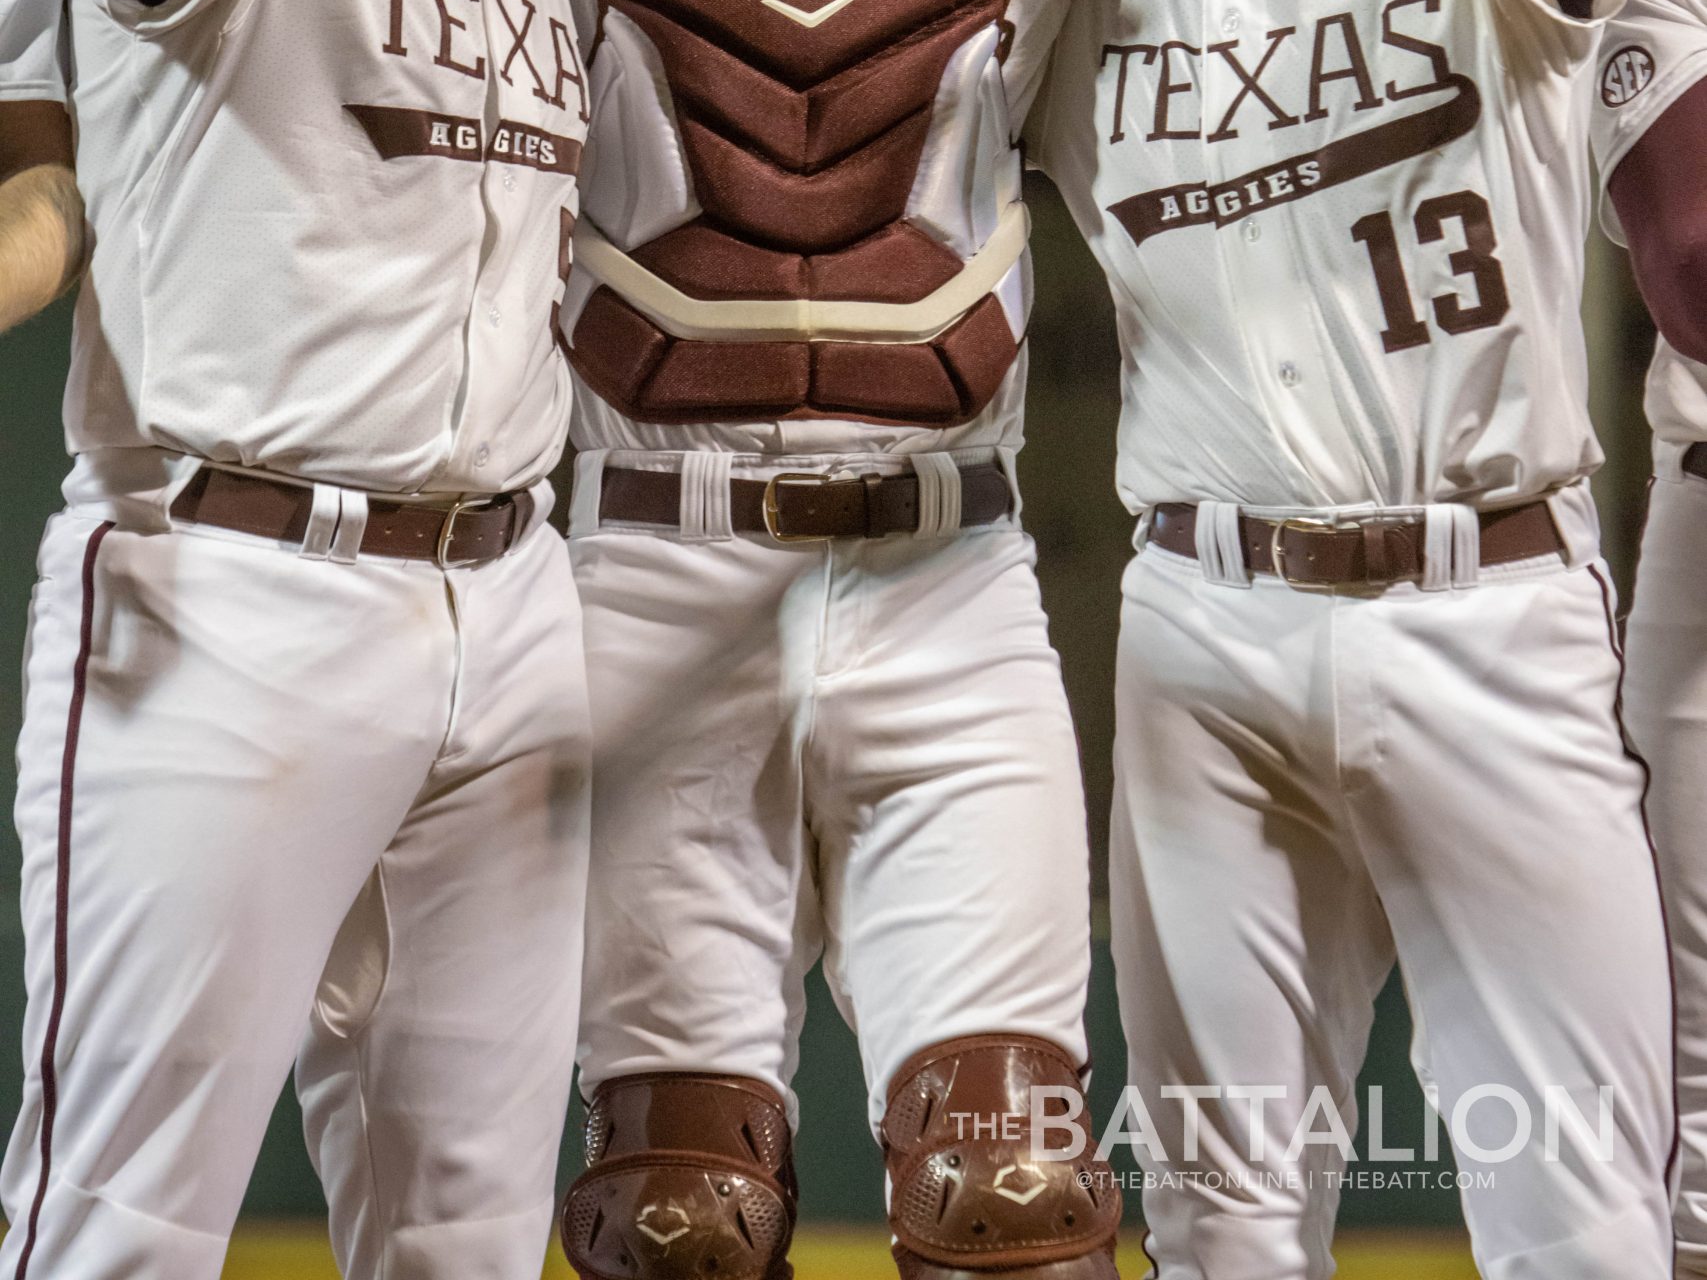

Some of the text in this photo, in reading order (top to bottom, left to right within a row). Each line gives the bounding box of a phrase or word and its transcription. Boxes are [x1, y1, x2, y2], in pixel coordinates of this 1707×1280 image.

[429, 121, 557, 164] AGGIES
[1160, 160, 1321, 221] AGGIES
[1350, 189, 1510, 354] 13
